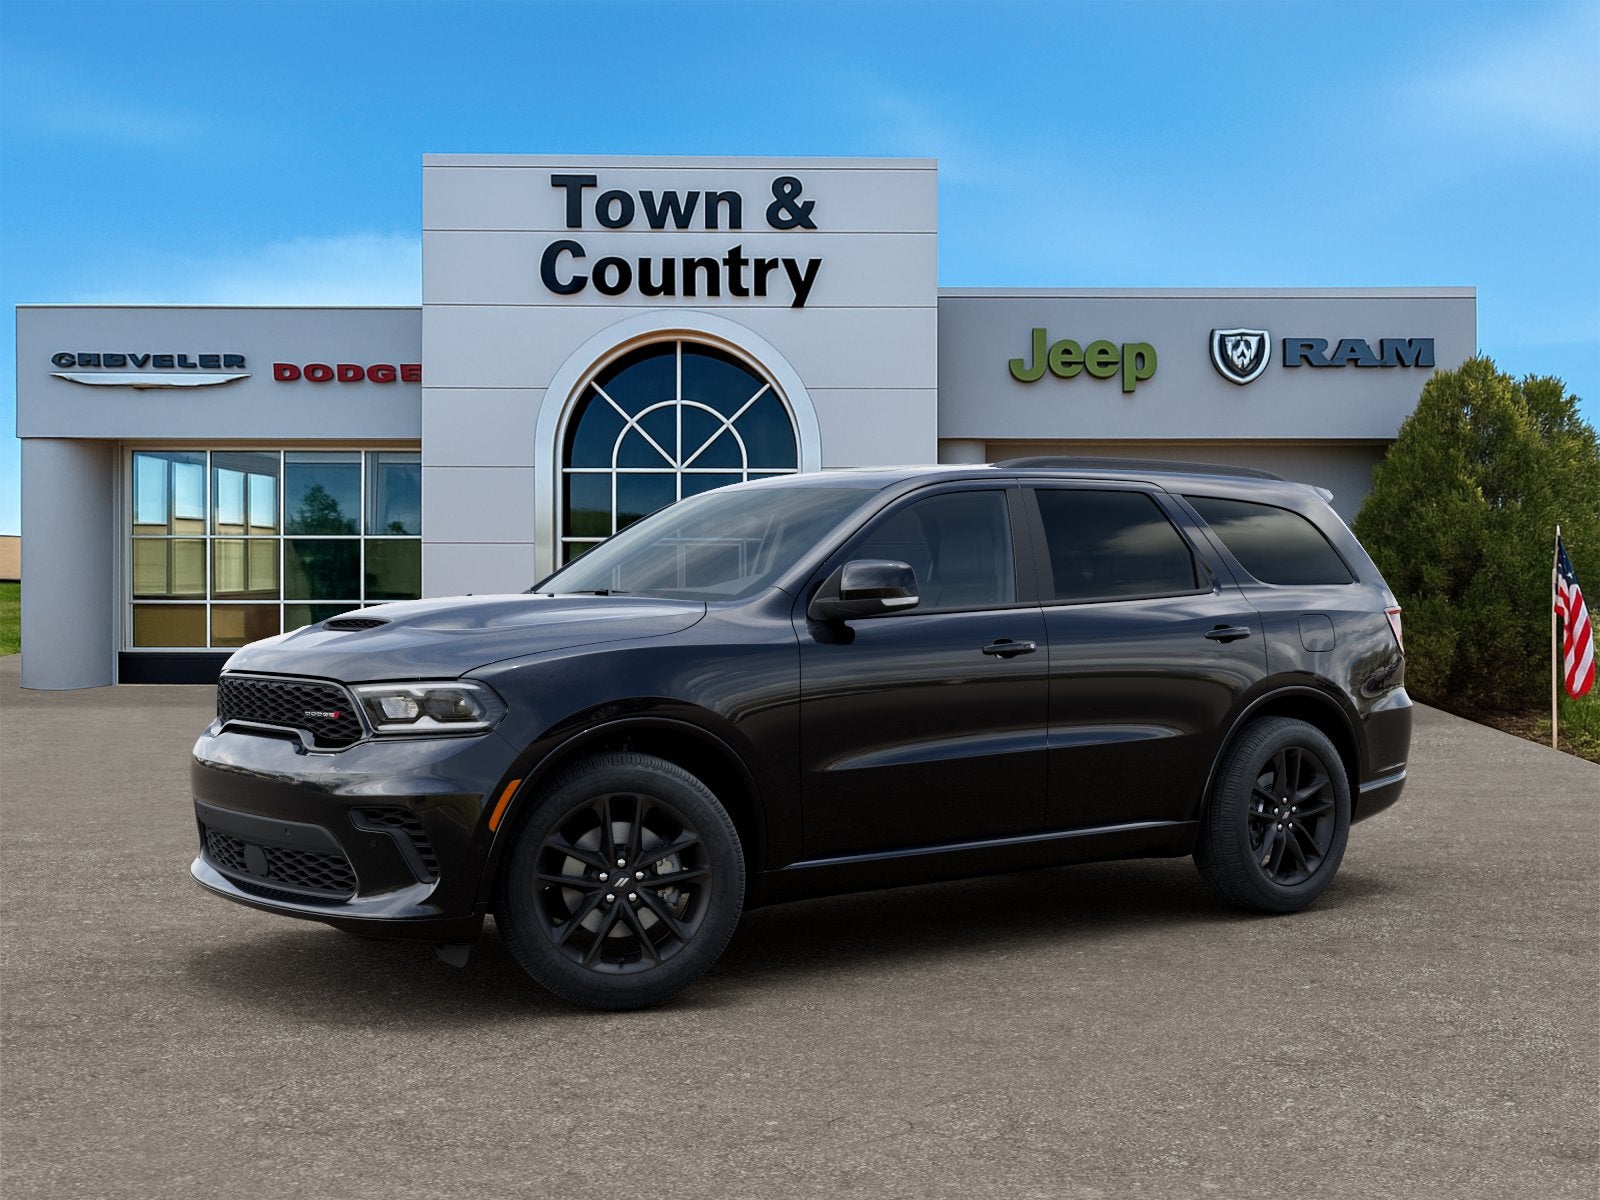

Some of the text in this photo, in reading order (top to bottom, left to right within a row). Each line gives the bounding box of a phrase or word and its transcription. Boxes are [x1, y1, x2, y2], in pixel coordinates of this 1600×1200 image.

[550, 174, 818, 230] Town &
[540, 239, 822, 308] Country
[272, 363, 422, 383] DODGE
[1009, 327, 1157, 393] Jeep
[1282, 337, 1435, 368] RAM
